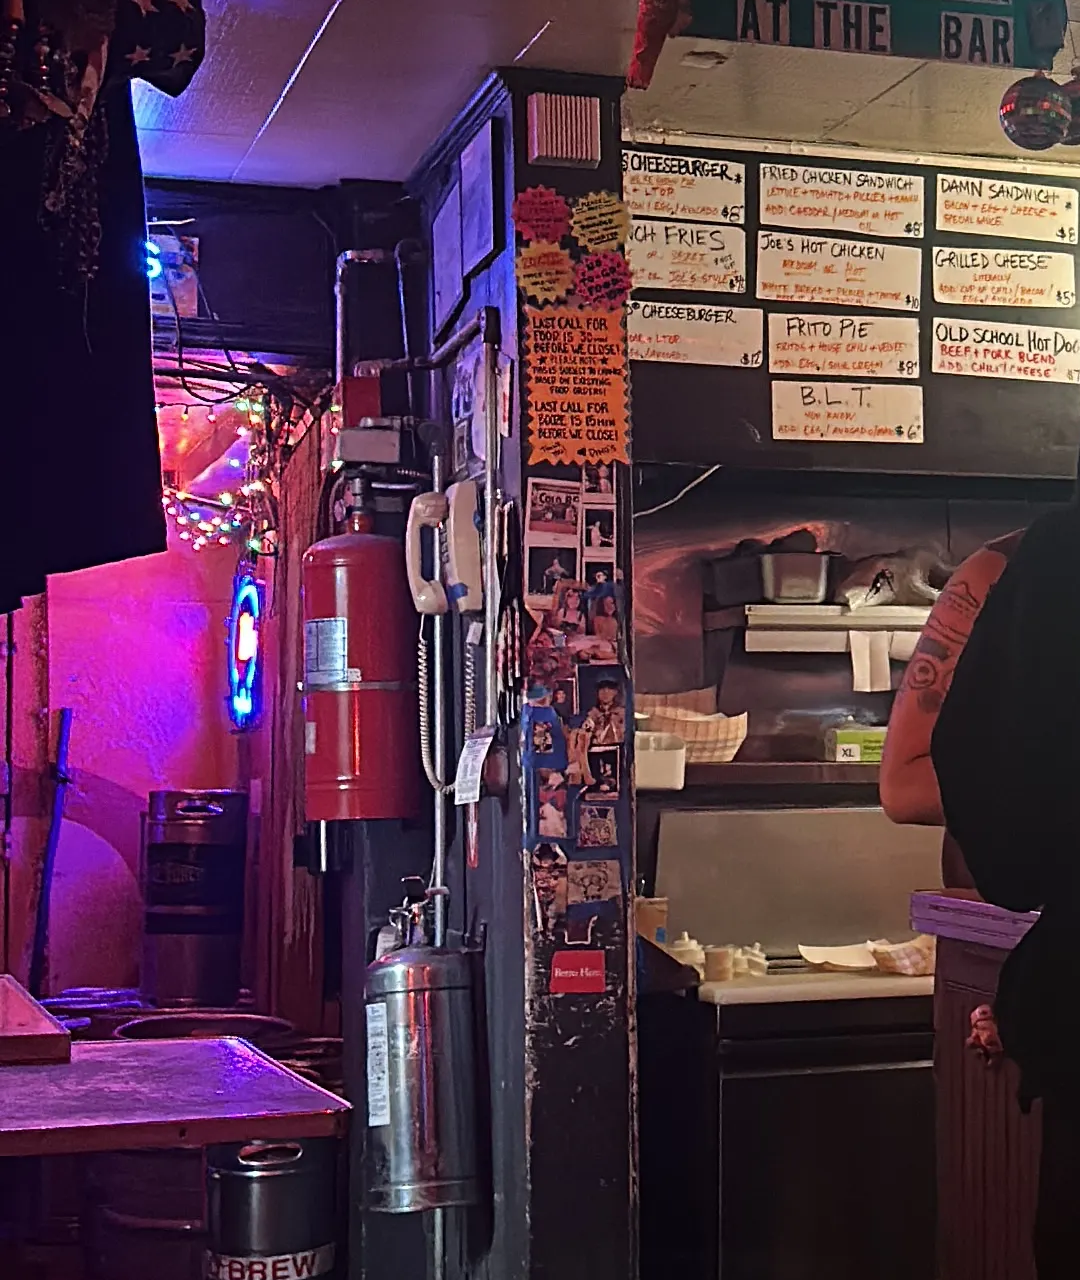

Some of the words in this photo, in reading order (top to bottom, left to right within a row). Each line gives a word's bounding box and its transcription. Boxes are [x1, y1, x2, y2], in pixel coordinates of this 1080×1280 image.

[816, 0, 887, 52] THE
[944, 14, 1012, 65] BAR
[631, 154, 732, 180] CHEESEBURGER
[763, 166, 798, 181] FRIED
[802, 170, 851, 186] CHICKEN
[856, 174, 913, 190] SANDWICH
[767, 187, 800, 199] LETTUCE
[941, 179, 982, 197] DAMN
[989, 184, 1059, 204] SANDWICH
[665, 225, 725, 251] FRIES
[760, 234, 795, 252] JOE'S
[801, 241, 828, 254] HOT
[831, 243, 885, 261] CHICKEN
[936, 249, 989, 269] GRILLED
[995, 253, 1052, 271] CHEESE
[533, 317, 555, 329] LAST
[557, 317, 582, 329] CALL
[586, 318, 608, 330] FOR
[642, 305, 736, 323] CHEESEBURGER
[534, 331, 559, 342] FOOD
[563, 331, 573, 342] IS
[787, 317, 832, 337] FRITO
[840, 319, 874, 339] PIE
[534, 343, 569, 354] BEFORE
[571, 344, 586, 355] WE
[935, 323, 969, 342] OLD
[973, 328, 1024, 347] SCHOOL
[1028, 330, 1051, 353] HOT
[1054, 332, 1080, 356] DOG
[1019, 351, 1056, 365] BLEND
[534, 401, 558, 412] LAST
[560, 402, 584, 413] CALL
[587, 402, 609, 413] FOR
[800, 386, 871, 408] B.L.T.
[538, 414, 567, 426] BOOZE
[570, 415, 582, 426] IS
[538, 428, 568, 439] BEFORE
[569, 429, 582, 439] WE
[842, 748, 854, 757] XL
